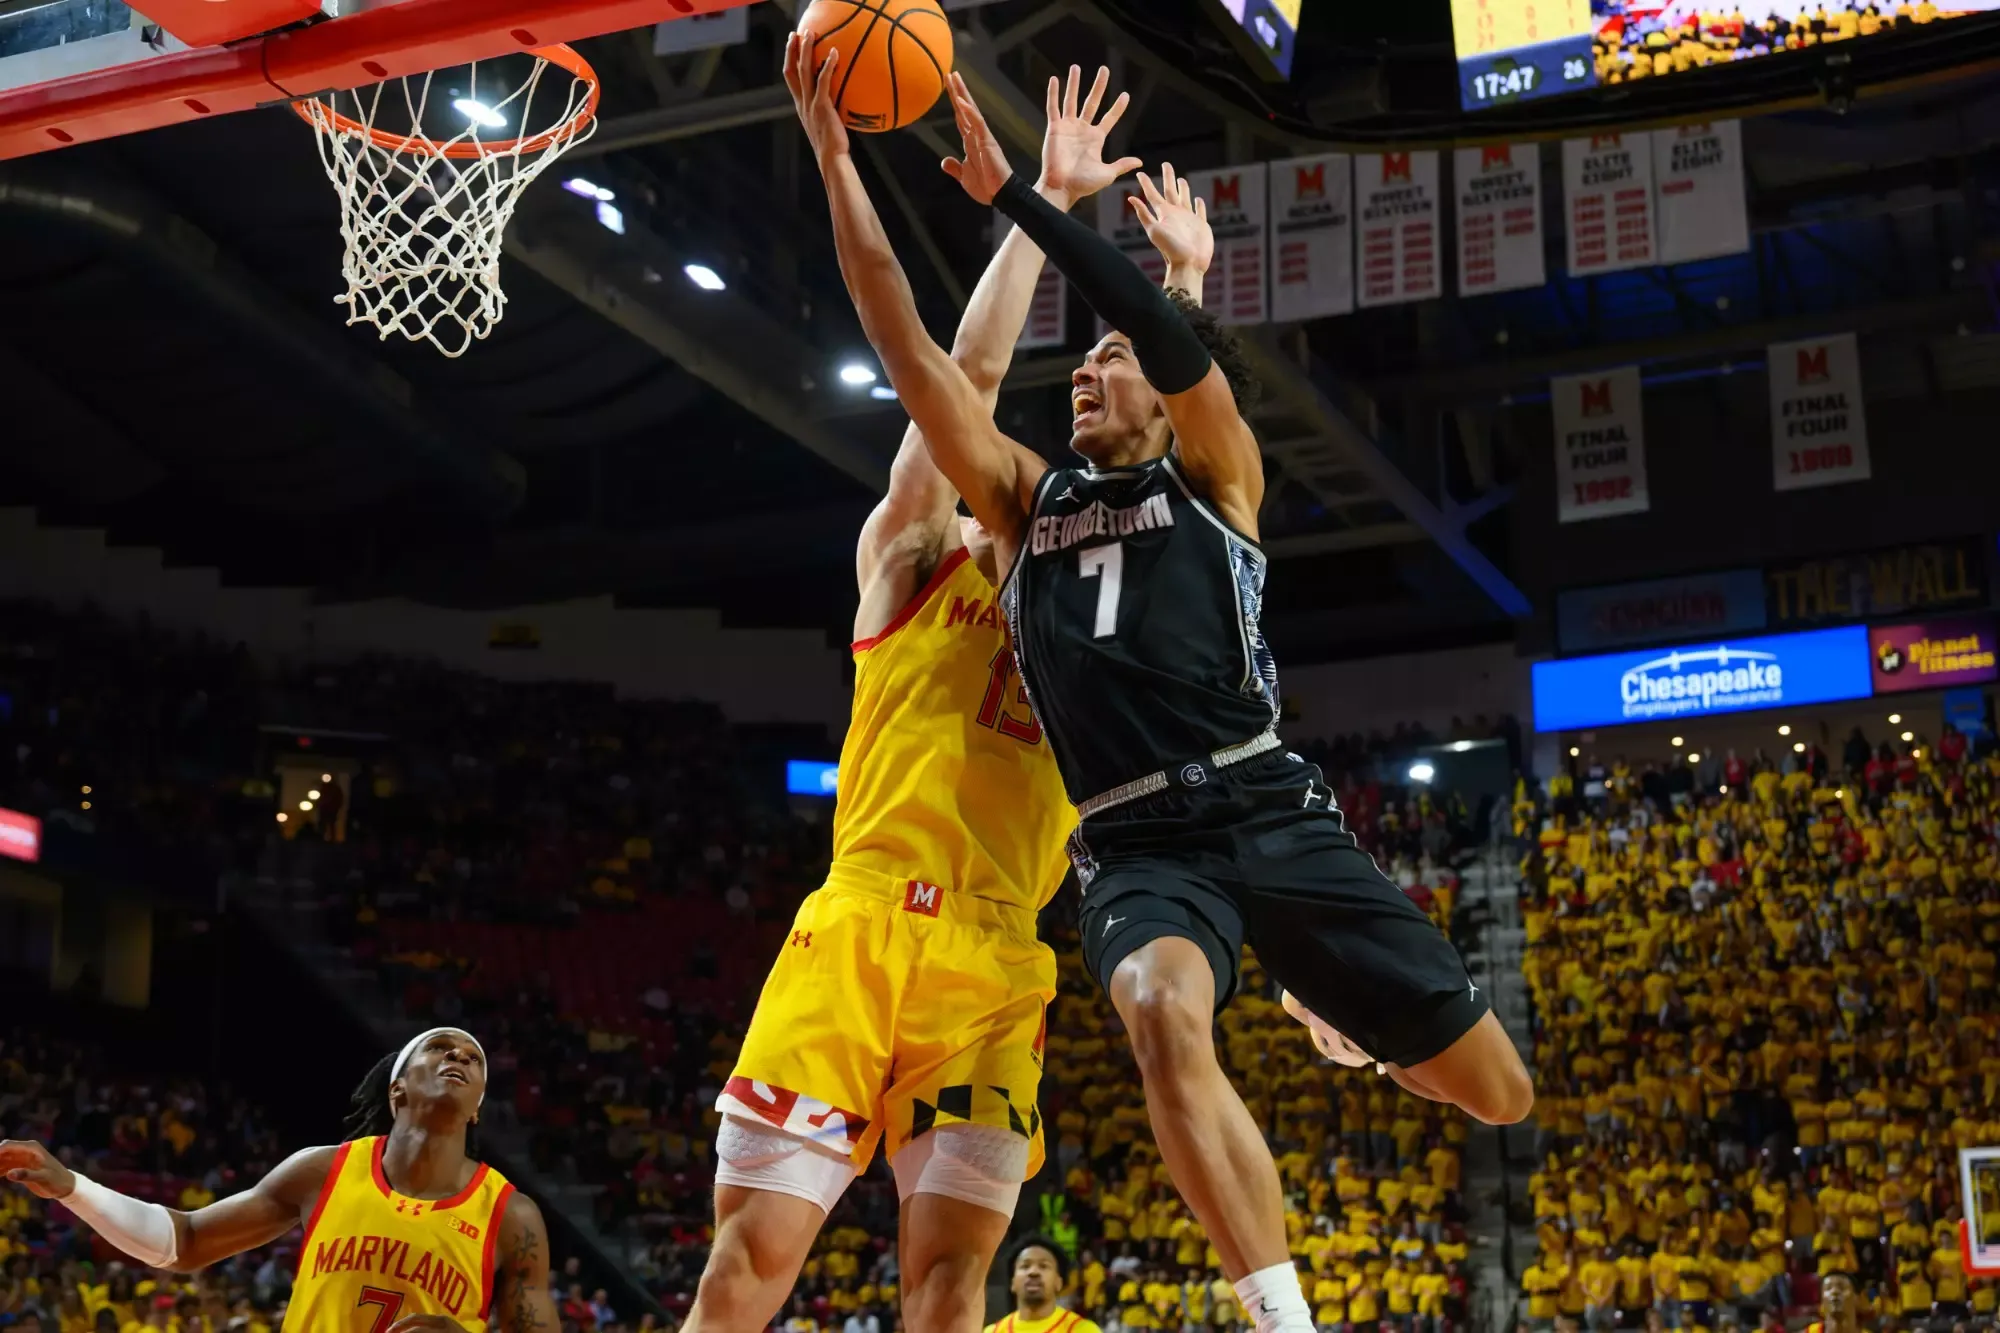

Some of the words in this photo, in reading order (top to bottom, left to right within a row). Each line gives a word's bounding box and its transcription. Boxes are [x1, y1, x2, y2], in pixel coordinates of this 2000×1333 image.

[1474, 66, 1534, 99] 17:47
[1213, 175, 1241, 209] M
[1296, 163, 1326, 198] M
[1797, 347, 1830, 384] M
[1580, 379, 1614, 416] M
[1782, 392, 1849, 417] FINAL
[1566, 426, 1629, 450] FINAL
[1787, 415, 1847, 438] FOUR
[1572, 447, 1627, 470] FOUR
[1032, 492, 1175, 556] GEORGETOWN
[1079, 542, 1123, 639] 7
[1770, 560, 1849, 620] THE
[1869, 548, 1981, 606] WALL
[1909, 634, 1979, 663] planet
[1919, 651, 1995, 674] fitness
[1620, 661, 1782, 707] Chesapeake
[912, 882, 938, 909] M
[312, 1236, 469, 1315] MARYLAND
[357, 1285, 405, 1333] 7
